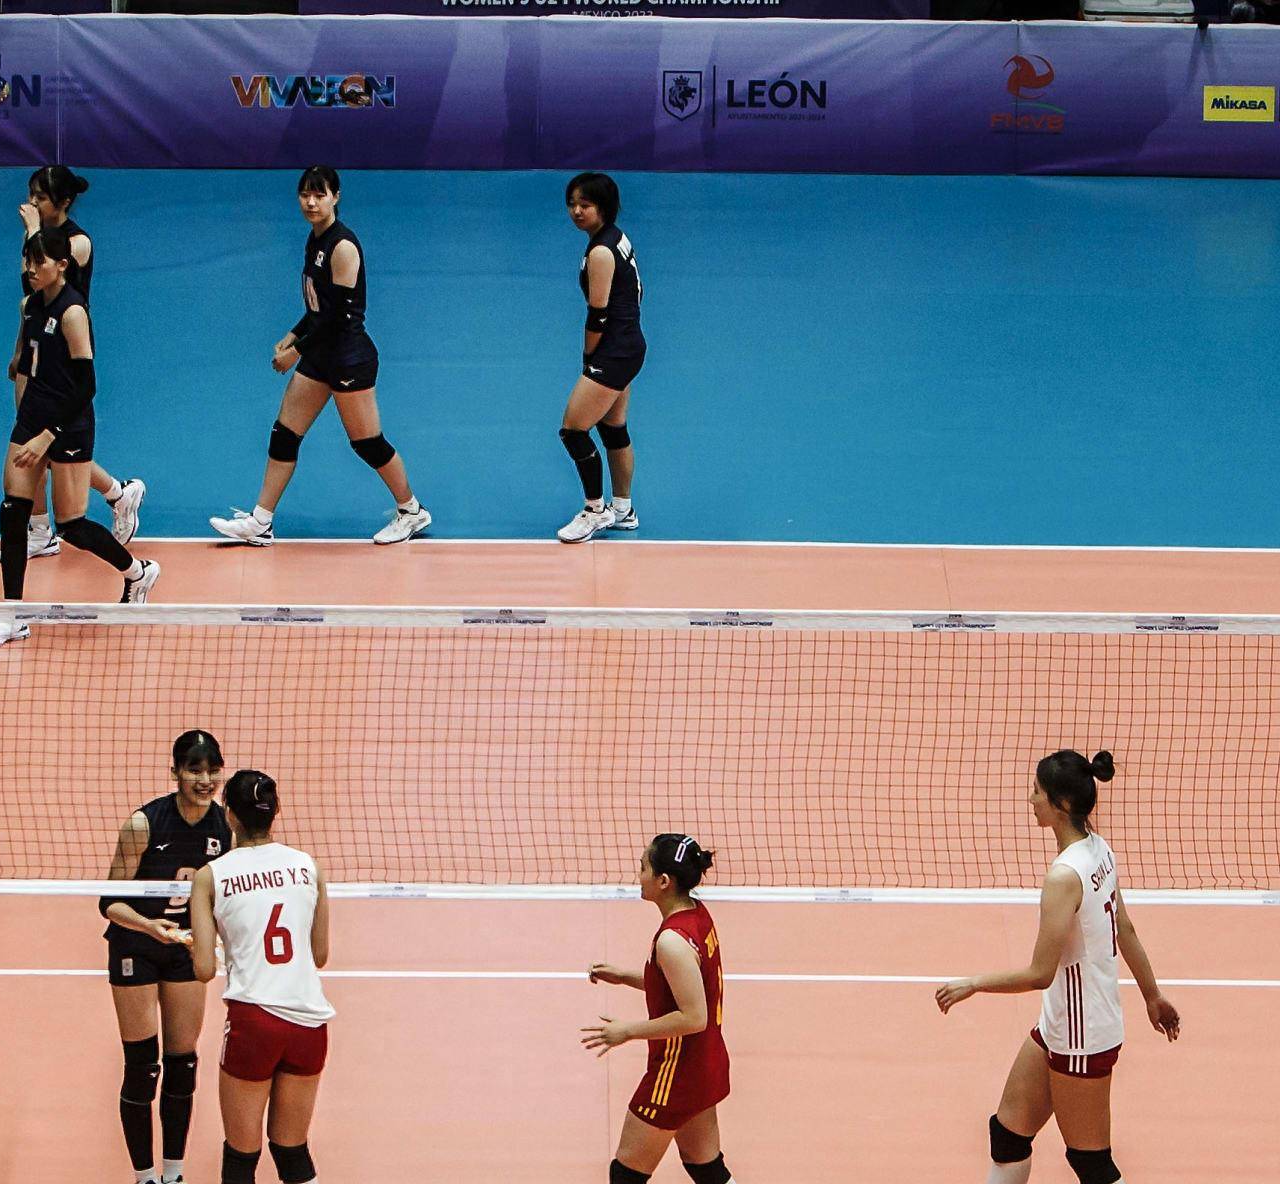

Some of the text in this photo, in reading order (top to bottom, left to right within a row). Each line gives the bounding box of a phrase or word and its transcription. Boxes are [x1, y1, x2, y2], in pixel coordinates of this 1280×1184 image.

[727, 72, 826, 108] LEÓN
[221, 870, 283, 898] ZHUANG
[264, 903, 293, 964] 6
